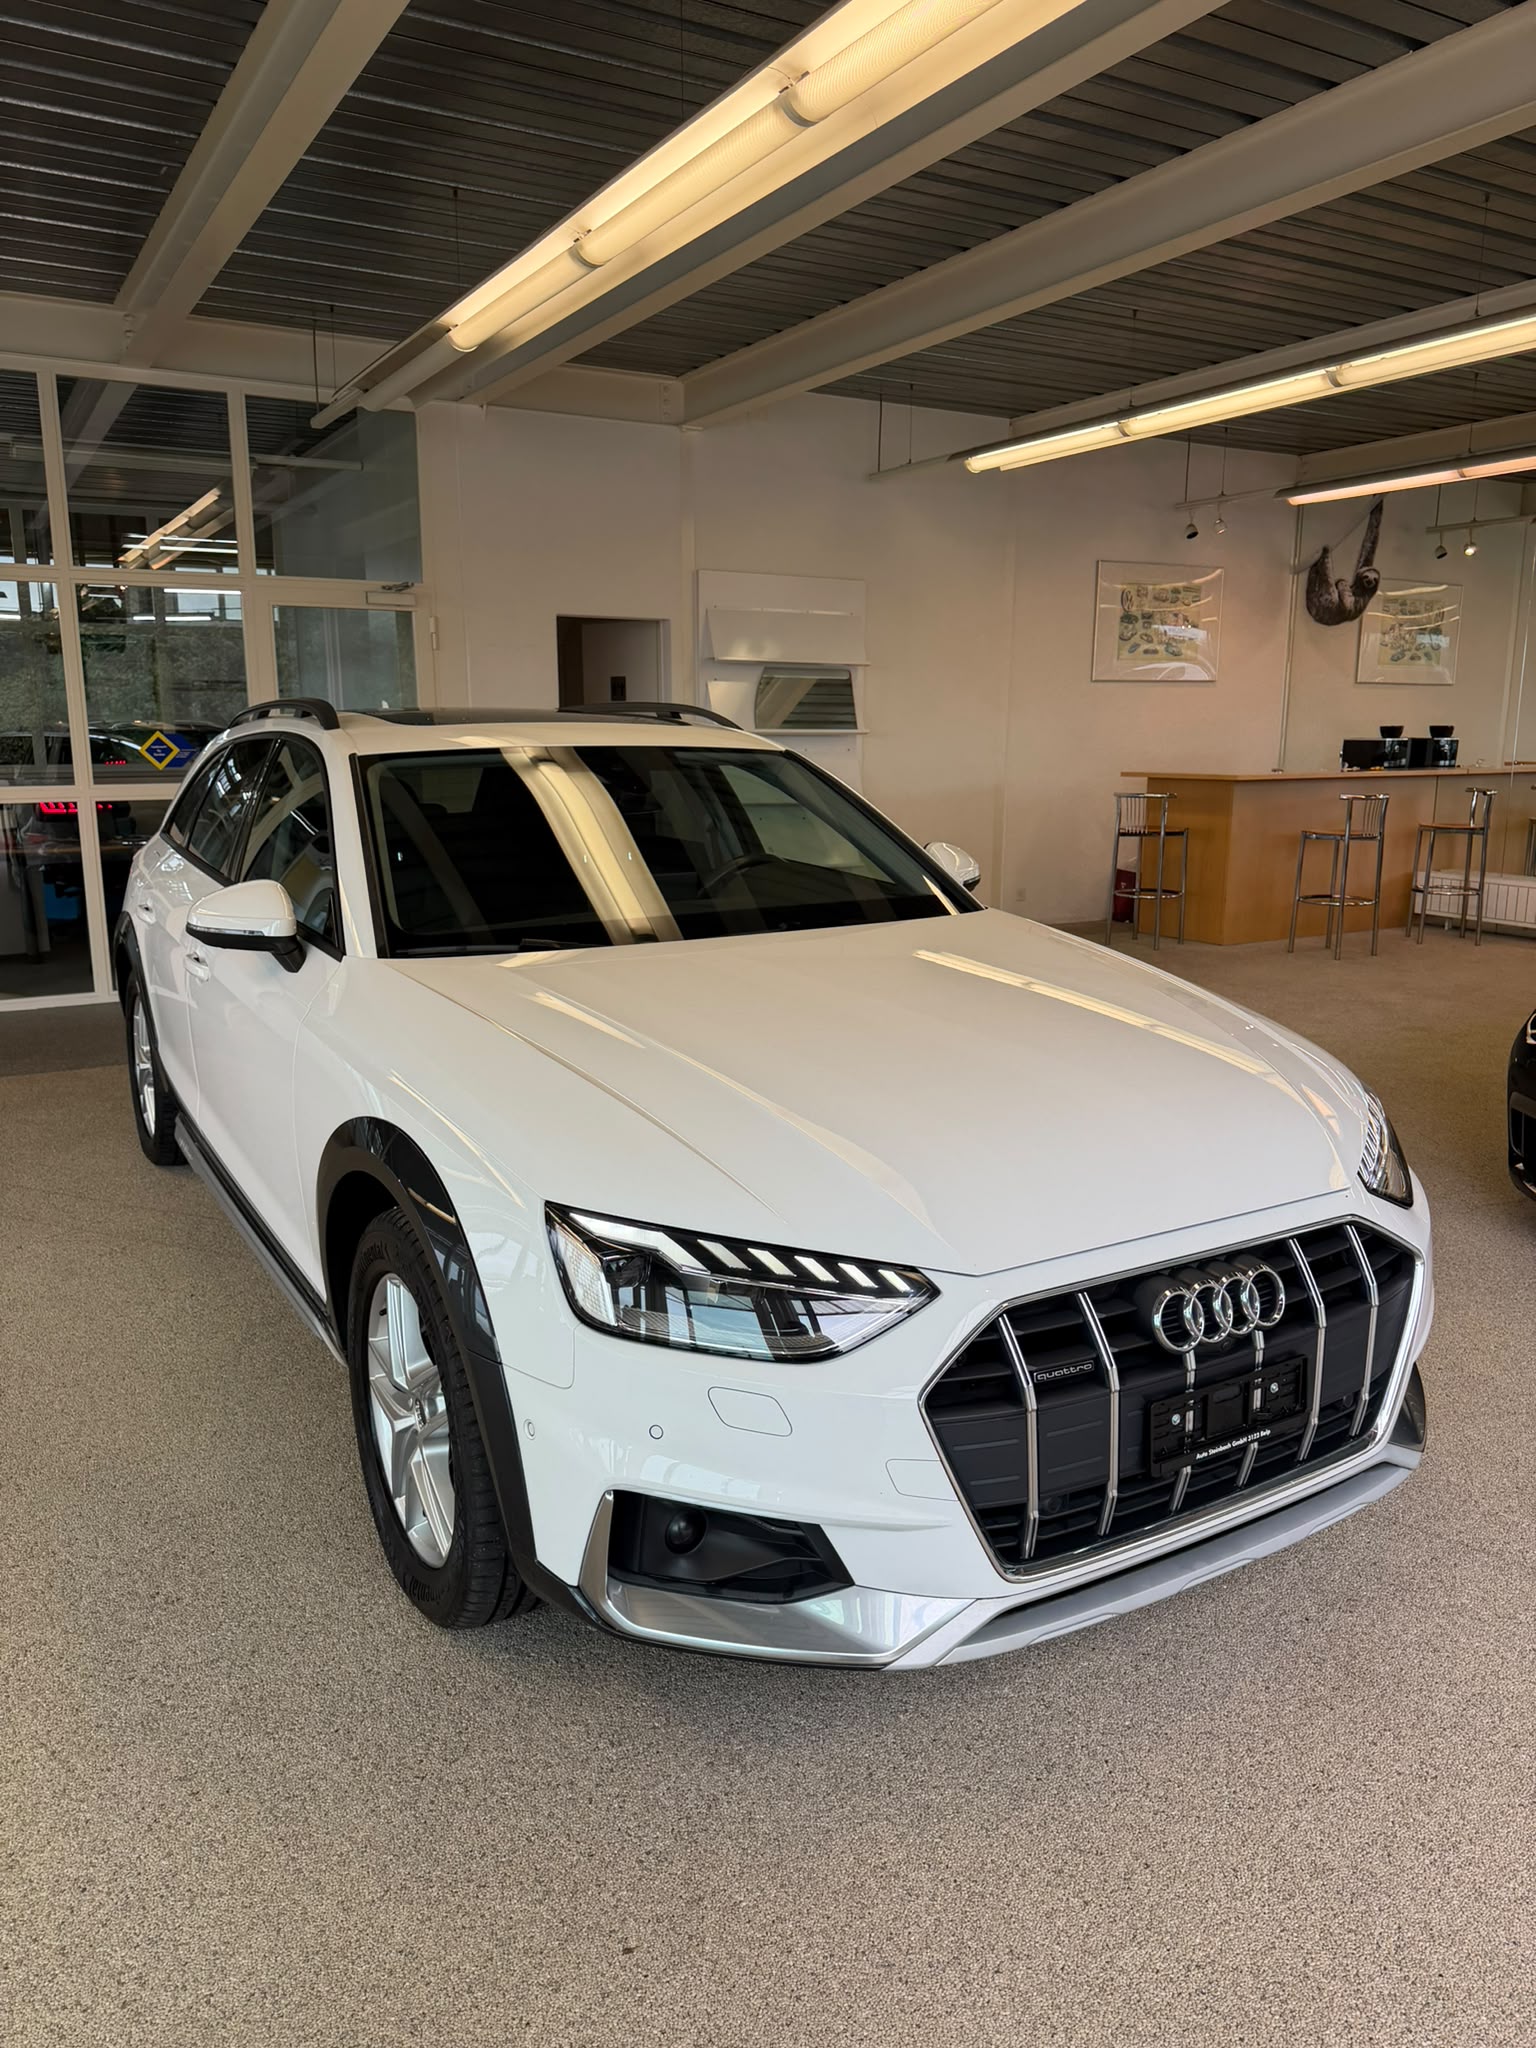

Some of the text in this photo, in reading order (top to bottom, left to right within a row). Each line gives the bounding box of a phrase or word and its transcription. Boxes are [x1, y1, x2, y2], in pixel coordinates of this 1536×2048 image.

[1037, 1364, 1092, 1380] quattro
[1196, 1451, 1208, 1460] Auto
[1232, 1436, 1247, 1447] GmbH
